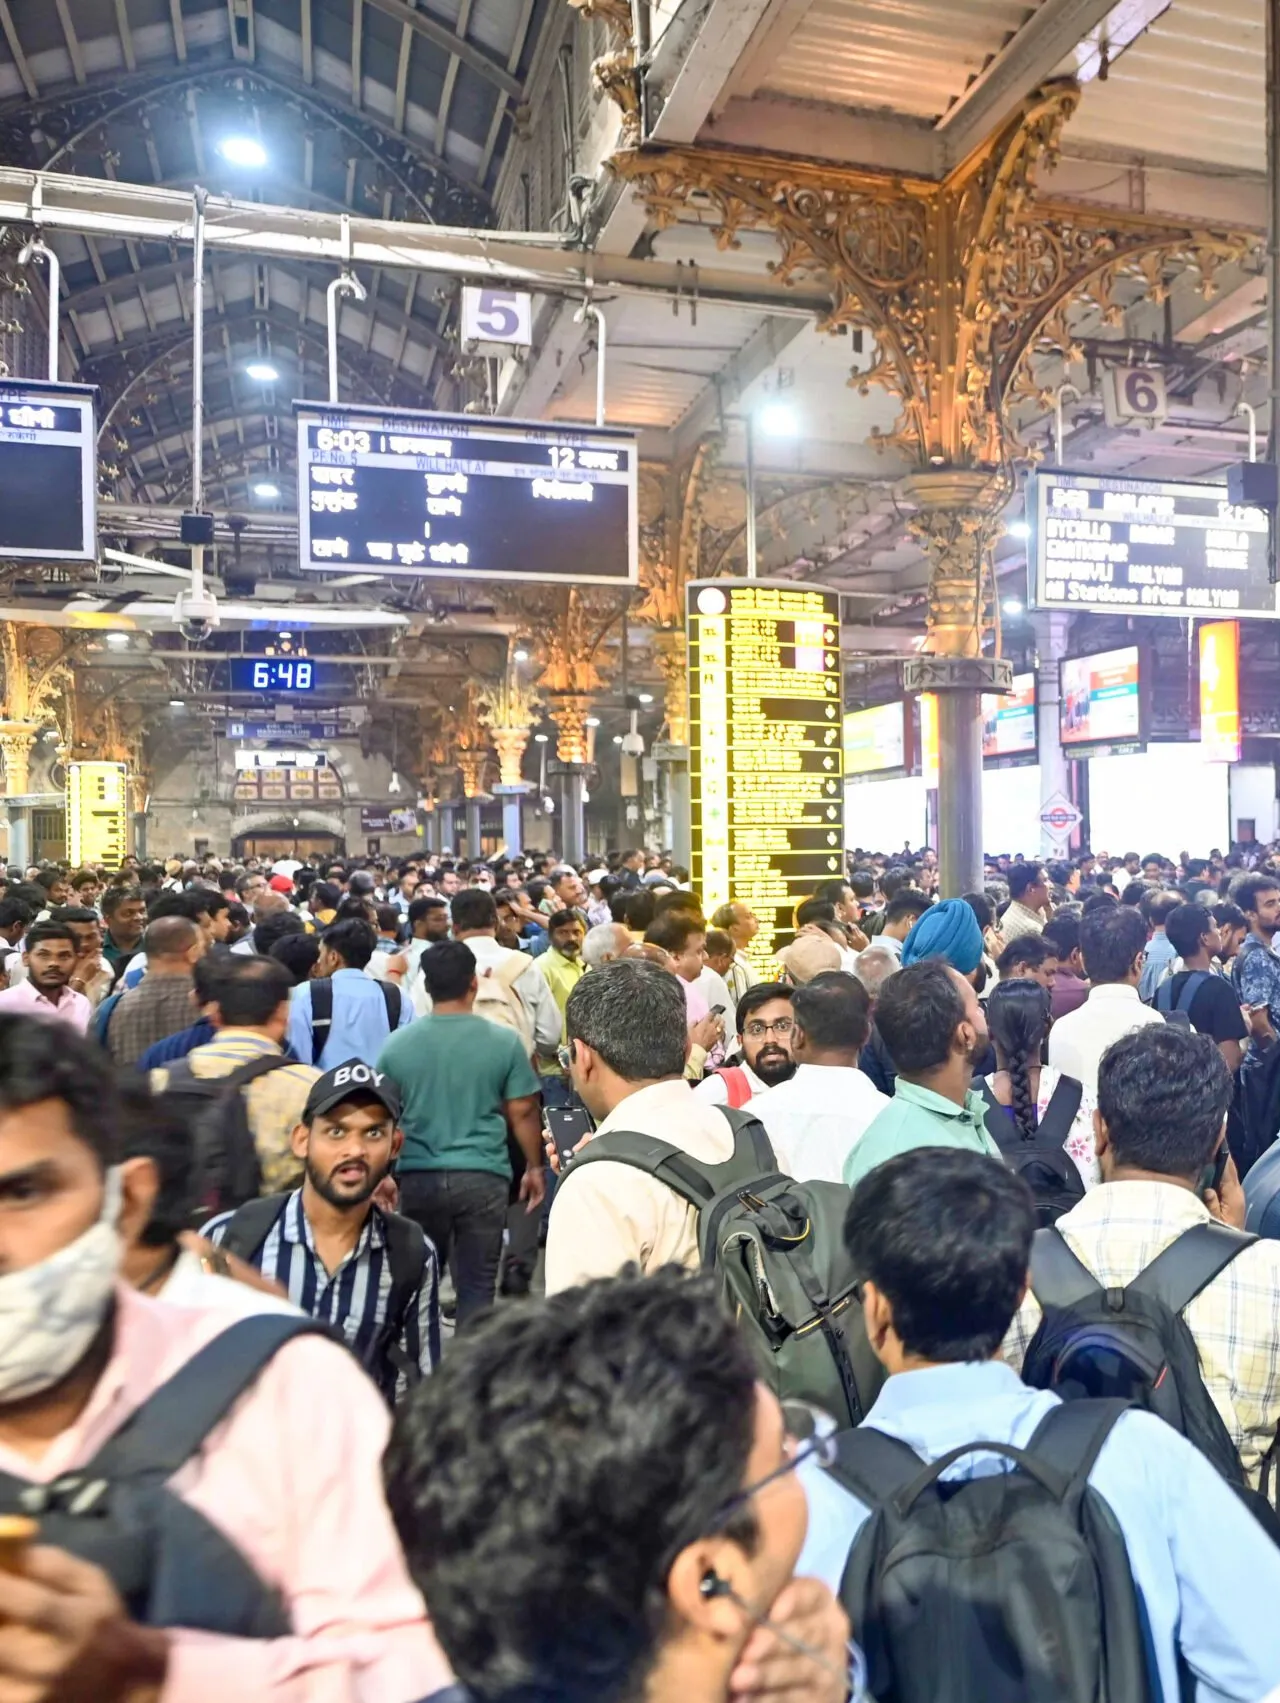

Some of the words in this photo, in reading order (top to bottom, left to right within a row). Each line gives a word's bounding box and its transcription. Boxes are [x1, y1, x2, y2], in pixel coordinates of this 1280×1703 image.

[476, 288, 520, 337] 5
[1125, 372, 1158, 413] 6
[320, 414, 350, 428] TIME
[382, 418, 469, 436] DESTINATION
[317, 428, 371, 454] 6:03
[557, 432, 588, 448] TYPE
[416, 456, 441, 471] WILL
[445, 458, 473, 473] HALT
[474, 460, 488, 473] AT
[548, 446, 576, 470] 12
[1067, 581, 1138, 603] Stations
[1141, 585, 1184, 606] After
[254, 662, 311, 689] 6:48
[333, 1064, 386, 1087] BOY
